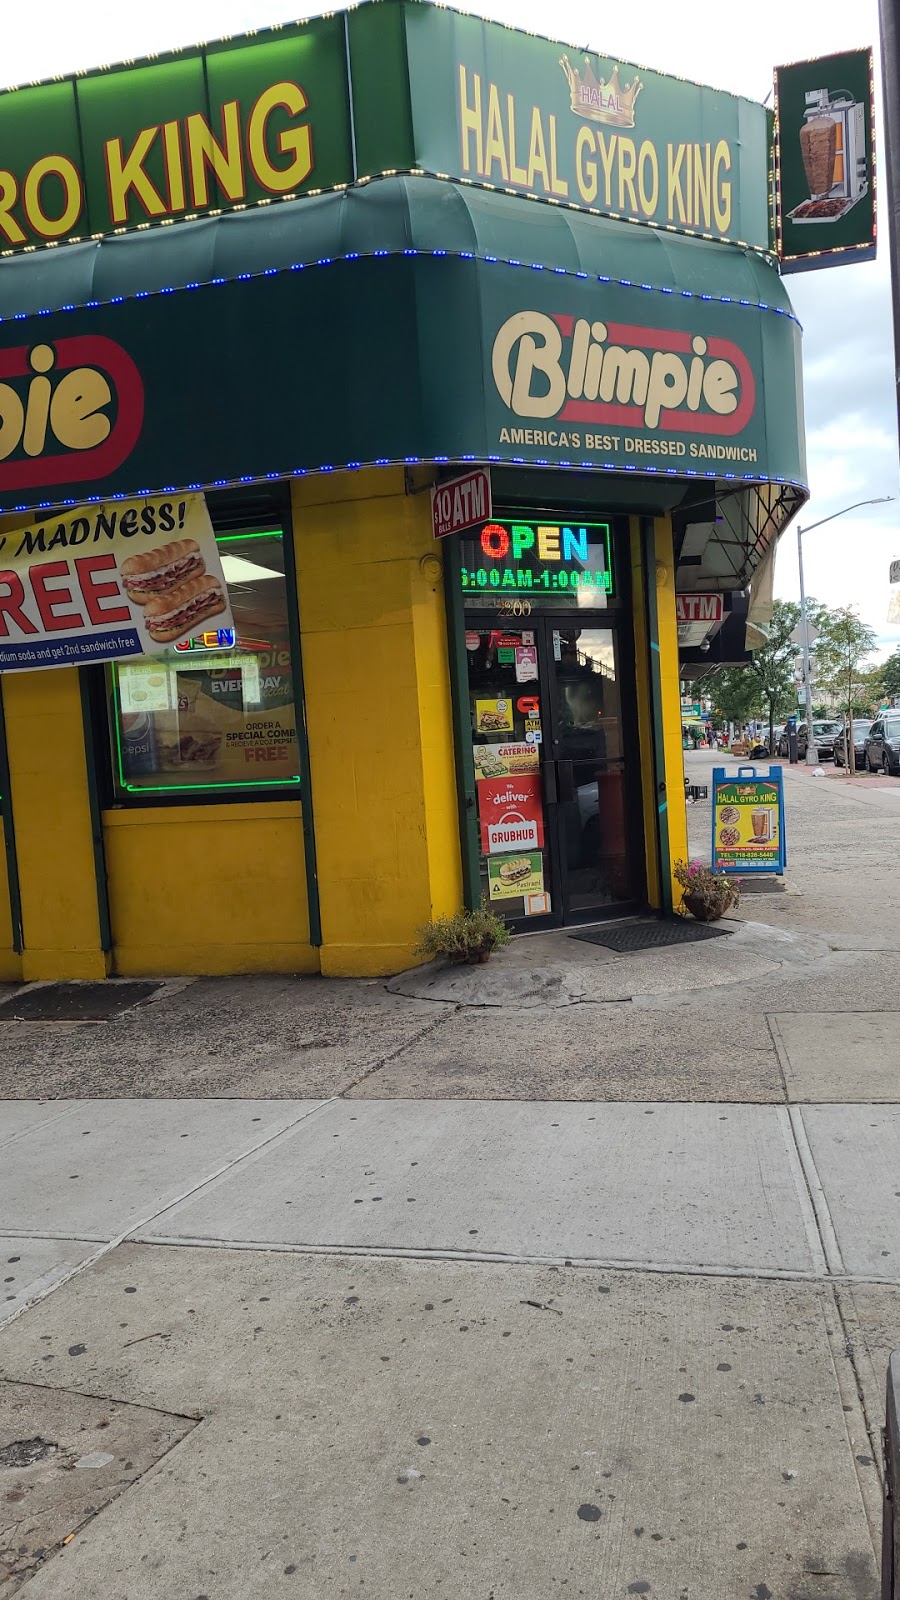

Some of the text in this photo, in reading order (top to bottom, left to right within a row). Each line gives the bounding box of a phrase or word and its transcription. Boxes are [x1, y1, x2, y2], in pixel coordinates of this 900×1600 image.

[580, 85, 624, 113] HALAL
[104, 80, 314, 225] KING
[459, 64, 732, 233] HALAL GYRO KING
[491, 310, 738, 429] Blimpie
[499, 427, 758, 462] AMERICA'S BEST DRESSED SANDWICH
[434, 475, 486, 527] $10 ATM
[14, 502, 186, 557] MADNESS!
[438, 521, 451, 534] BILLS
[480, 524, 589, 561] OPEN
[497, 600, 532, 617] 2200
[677, 596, 718, 620] ATM
[19, 649, 36, 661] soda
[36, 647, 51, 660] and
[52, 646, 65, 660] get
[65, 643, 80, 656] 2nd
[80, 639, 118, 654] sandwich
[118, 637, 135, 649] free
[226, 731, 267, 741] SPECIAL
[245, 722, 281, 731] ORDER A
[244, 745, 288, 763] FREE
[497, 746, 537, 757] CATERING
[493, 791, 529, 805] deliver
[717, 792, 777, 803] HALAL GYRO KING
[491, 828, 535, 844] GRUBHUB
